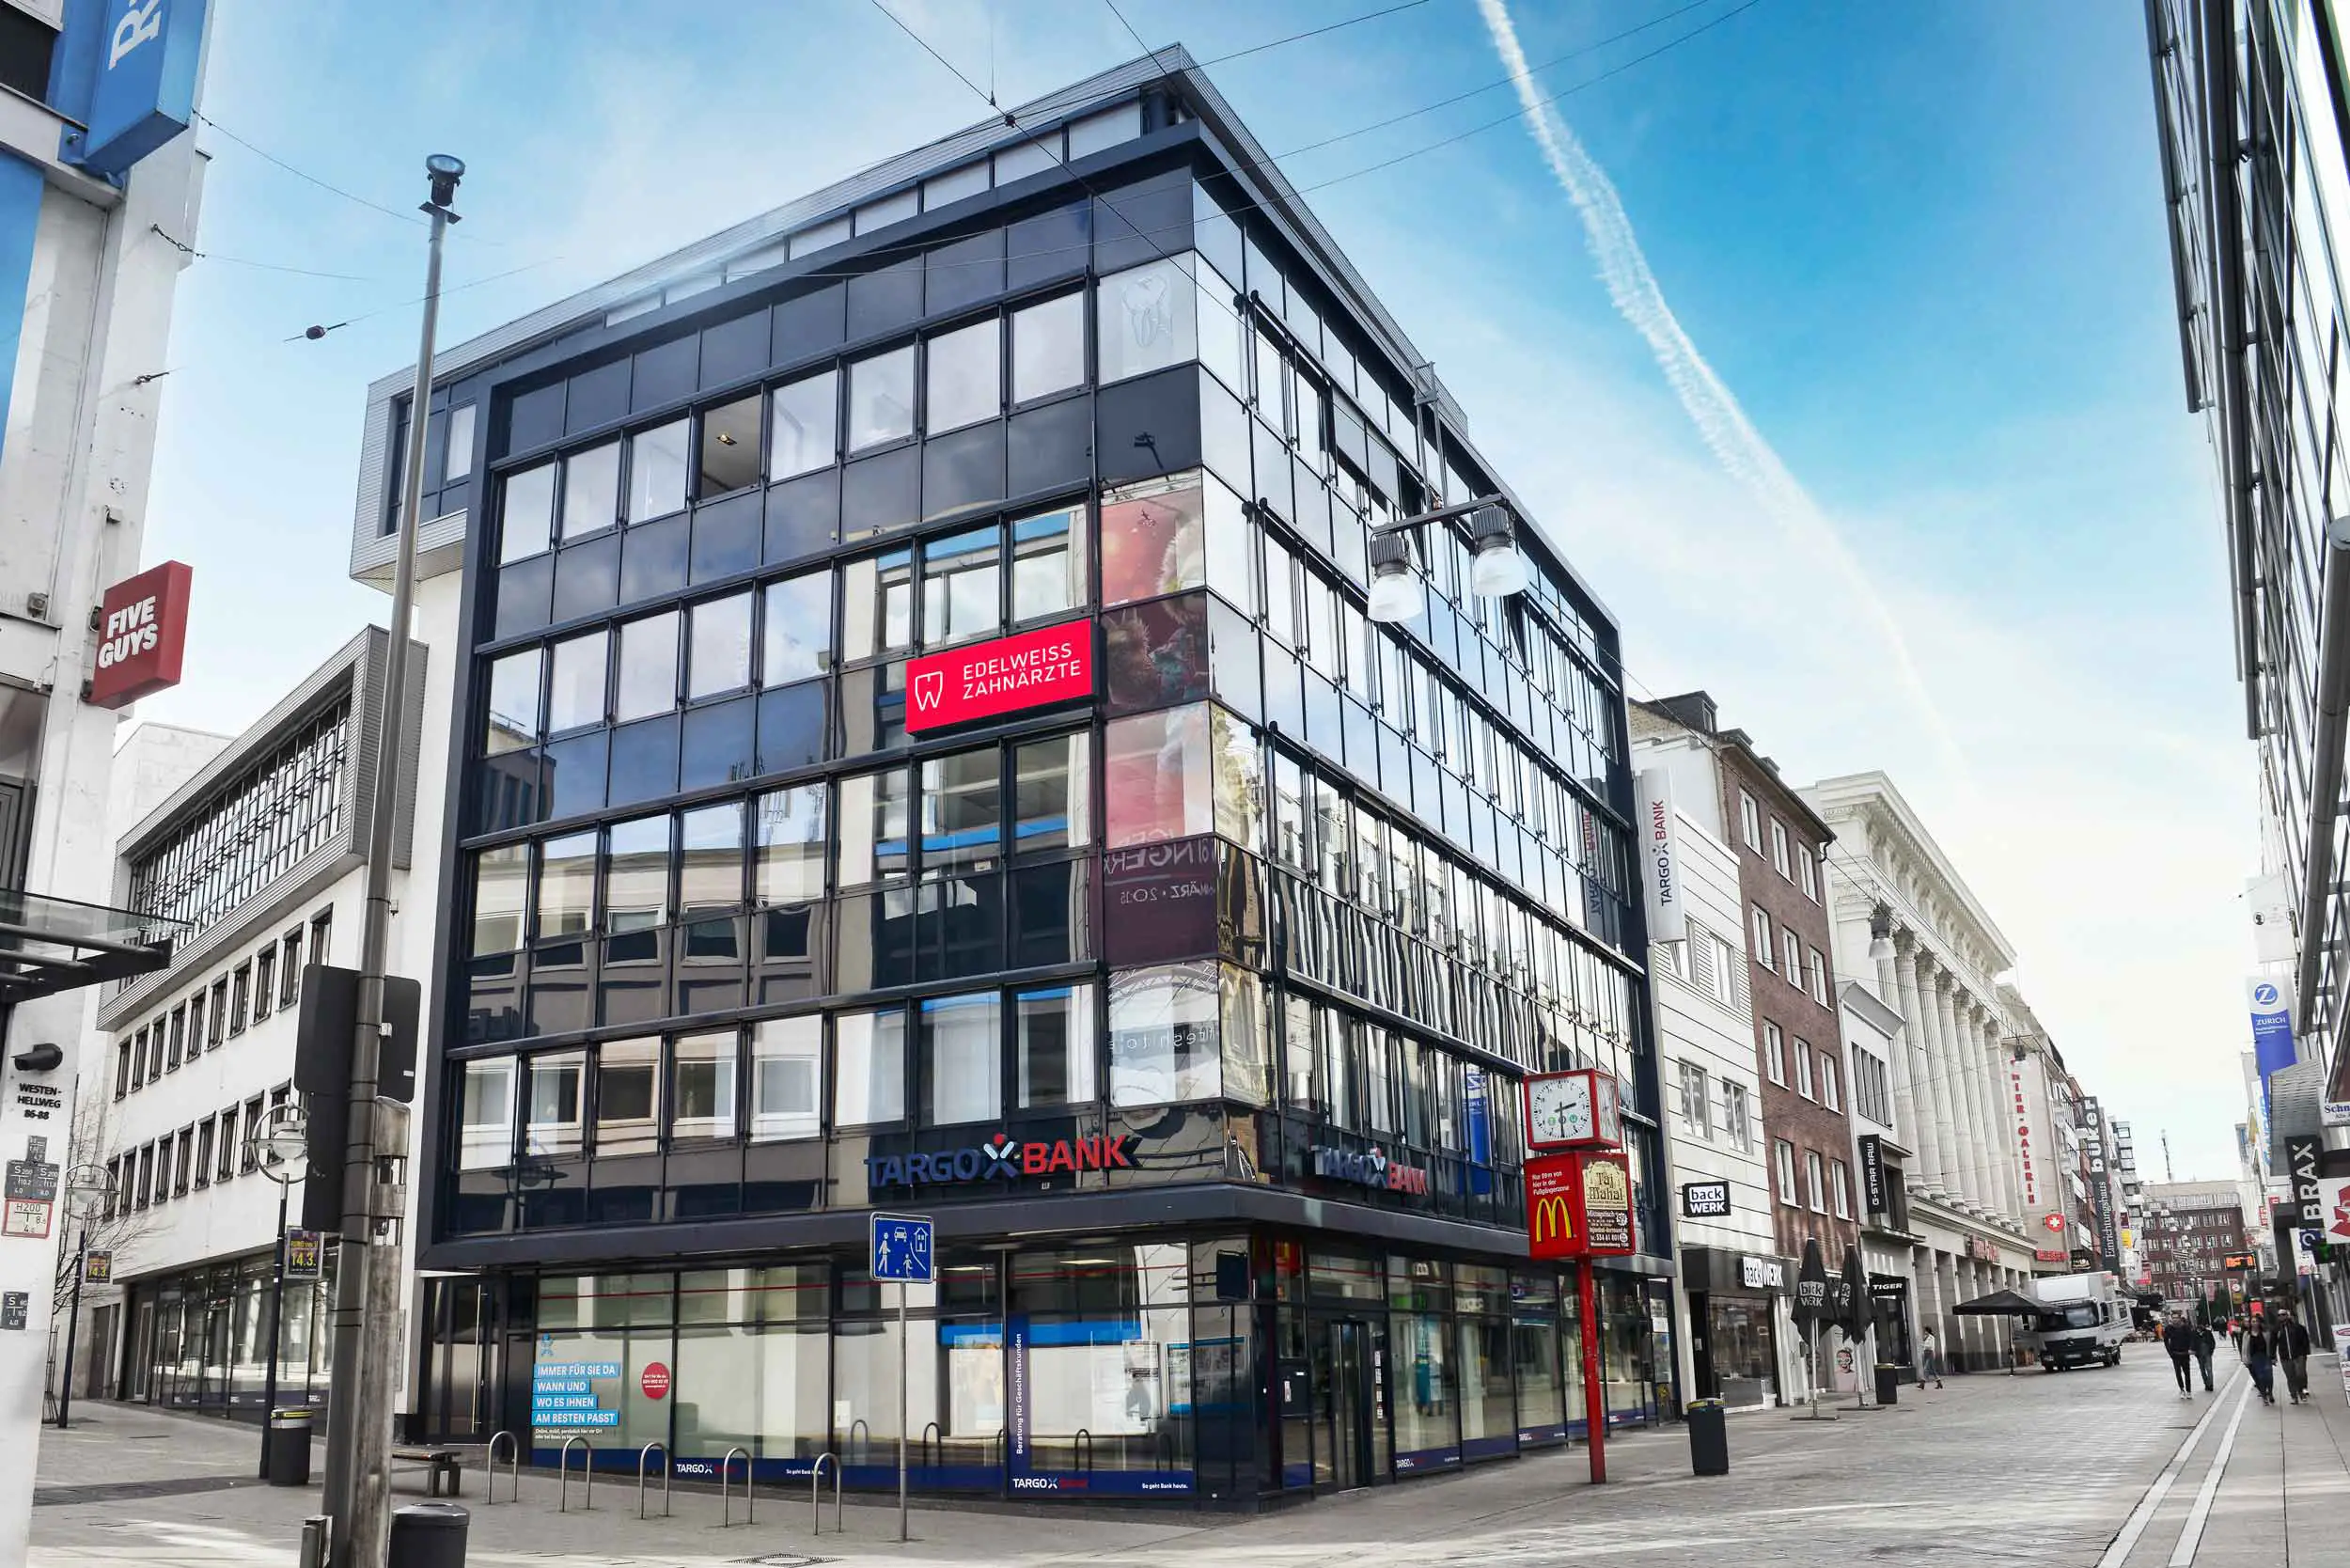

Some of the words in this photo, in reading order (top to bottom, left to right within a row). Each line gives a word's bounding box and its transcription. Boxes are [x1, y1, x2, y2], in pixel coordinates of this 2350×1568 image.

[106, 595, 156, 639] FIVE
[98, 623, 158, 668] GUYS
[963, 643, 1073, 681] EDELWEISS
[963, 660, 1081, 700] ZAHNÄRZTE
[2256, 1017, 2286, 1026] ZURICH
[19, 1082, 62, 1096] WESTEN-
[17, 1095, 61, 1108] HELLWEG
[1867, 1142, 1875, 1166] RAW
[1595, 1172, 1614, 1189] Taj
[2292, 1142, 2323, 1220] BRAX
[1589, 1186, 1623, 1200] Mahal
[1691, 1187, 1723, 1200] back
[1689, 1202, 1726, 1214] WERK
[2098, 1181, 2116, 1258] Einrichtungshaus
[538, 1365, 568, 1376] IMMER
[569, 1364, 585, 1376] FÜR
[587, 1365, 601, 1375] SIE
[603, 1364, 616, 1375] DA
[537, 1381, 566, 1392] WANN
[567, 1381, 587, 1391] UND
[536, 1397, 553, 1408] WO
[554, 1397, 565, 1407] ES
[566, 1397, 595, 1407] IHNEN
[535, 1414, 550, 1423] AM
[552, 1413, 585, 1424] BESTEN
[587, 1413, 616, 1423] PASST
[676, 1464, 705, 1474] TARGO
[1012, 1478, 1047, 1489] TARGO
